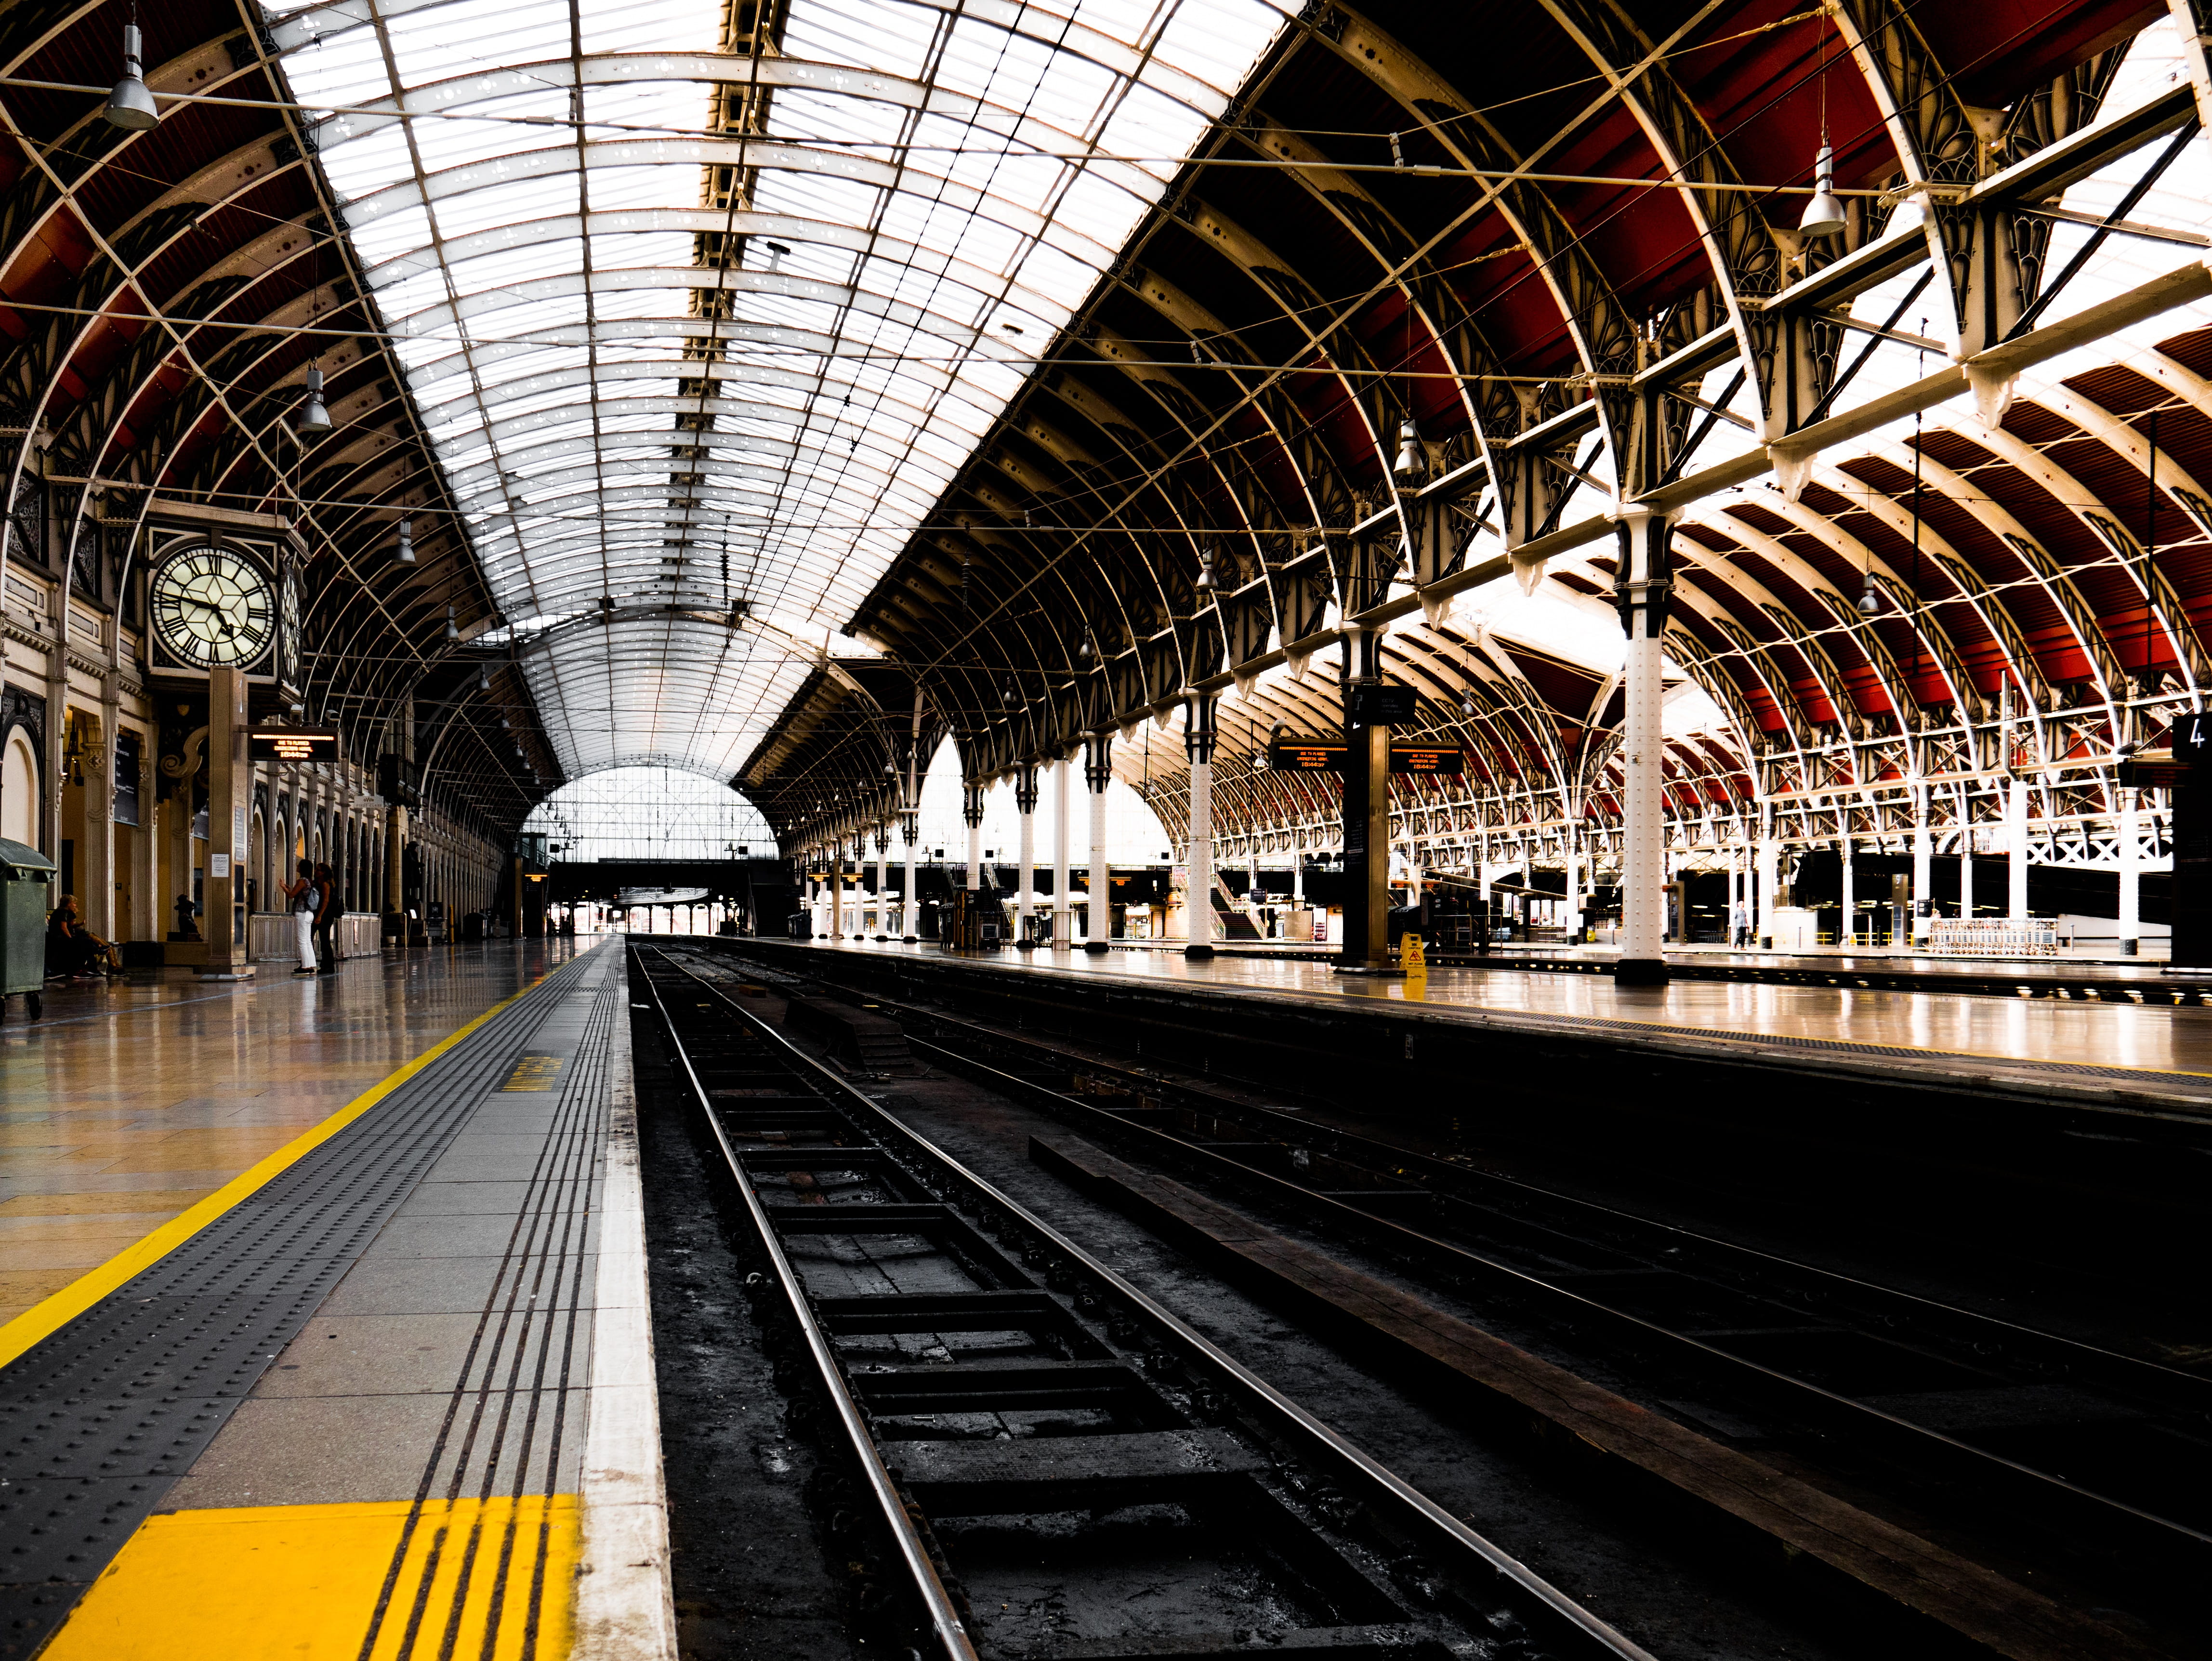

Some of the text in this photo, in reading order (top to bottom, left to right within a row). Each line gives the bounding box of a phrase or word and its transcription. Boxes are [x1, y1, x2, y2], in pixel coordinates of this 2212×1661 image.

[208, 555, 223, 575] XII
[248, 607, 267, 620] III
[2190, 719, 2205, 748] 4
[512, 1066, 562, 1076] THE
